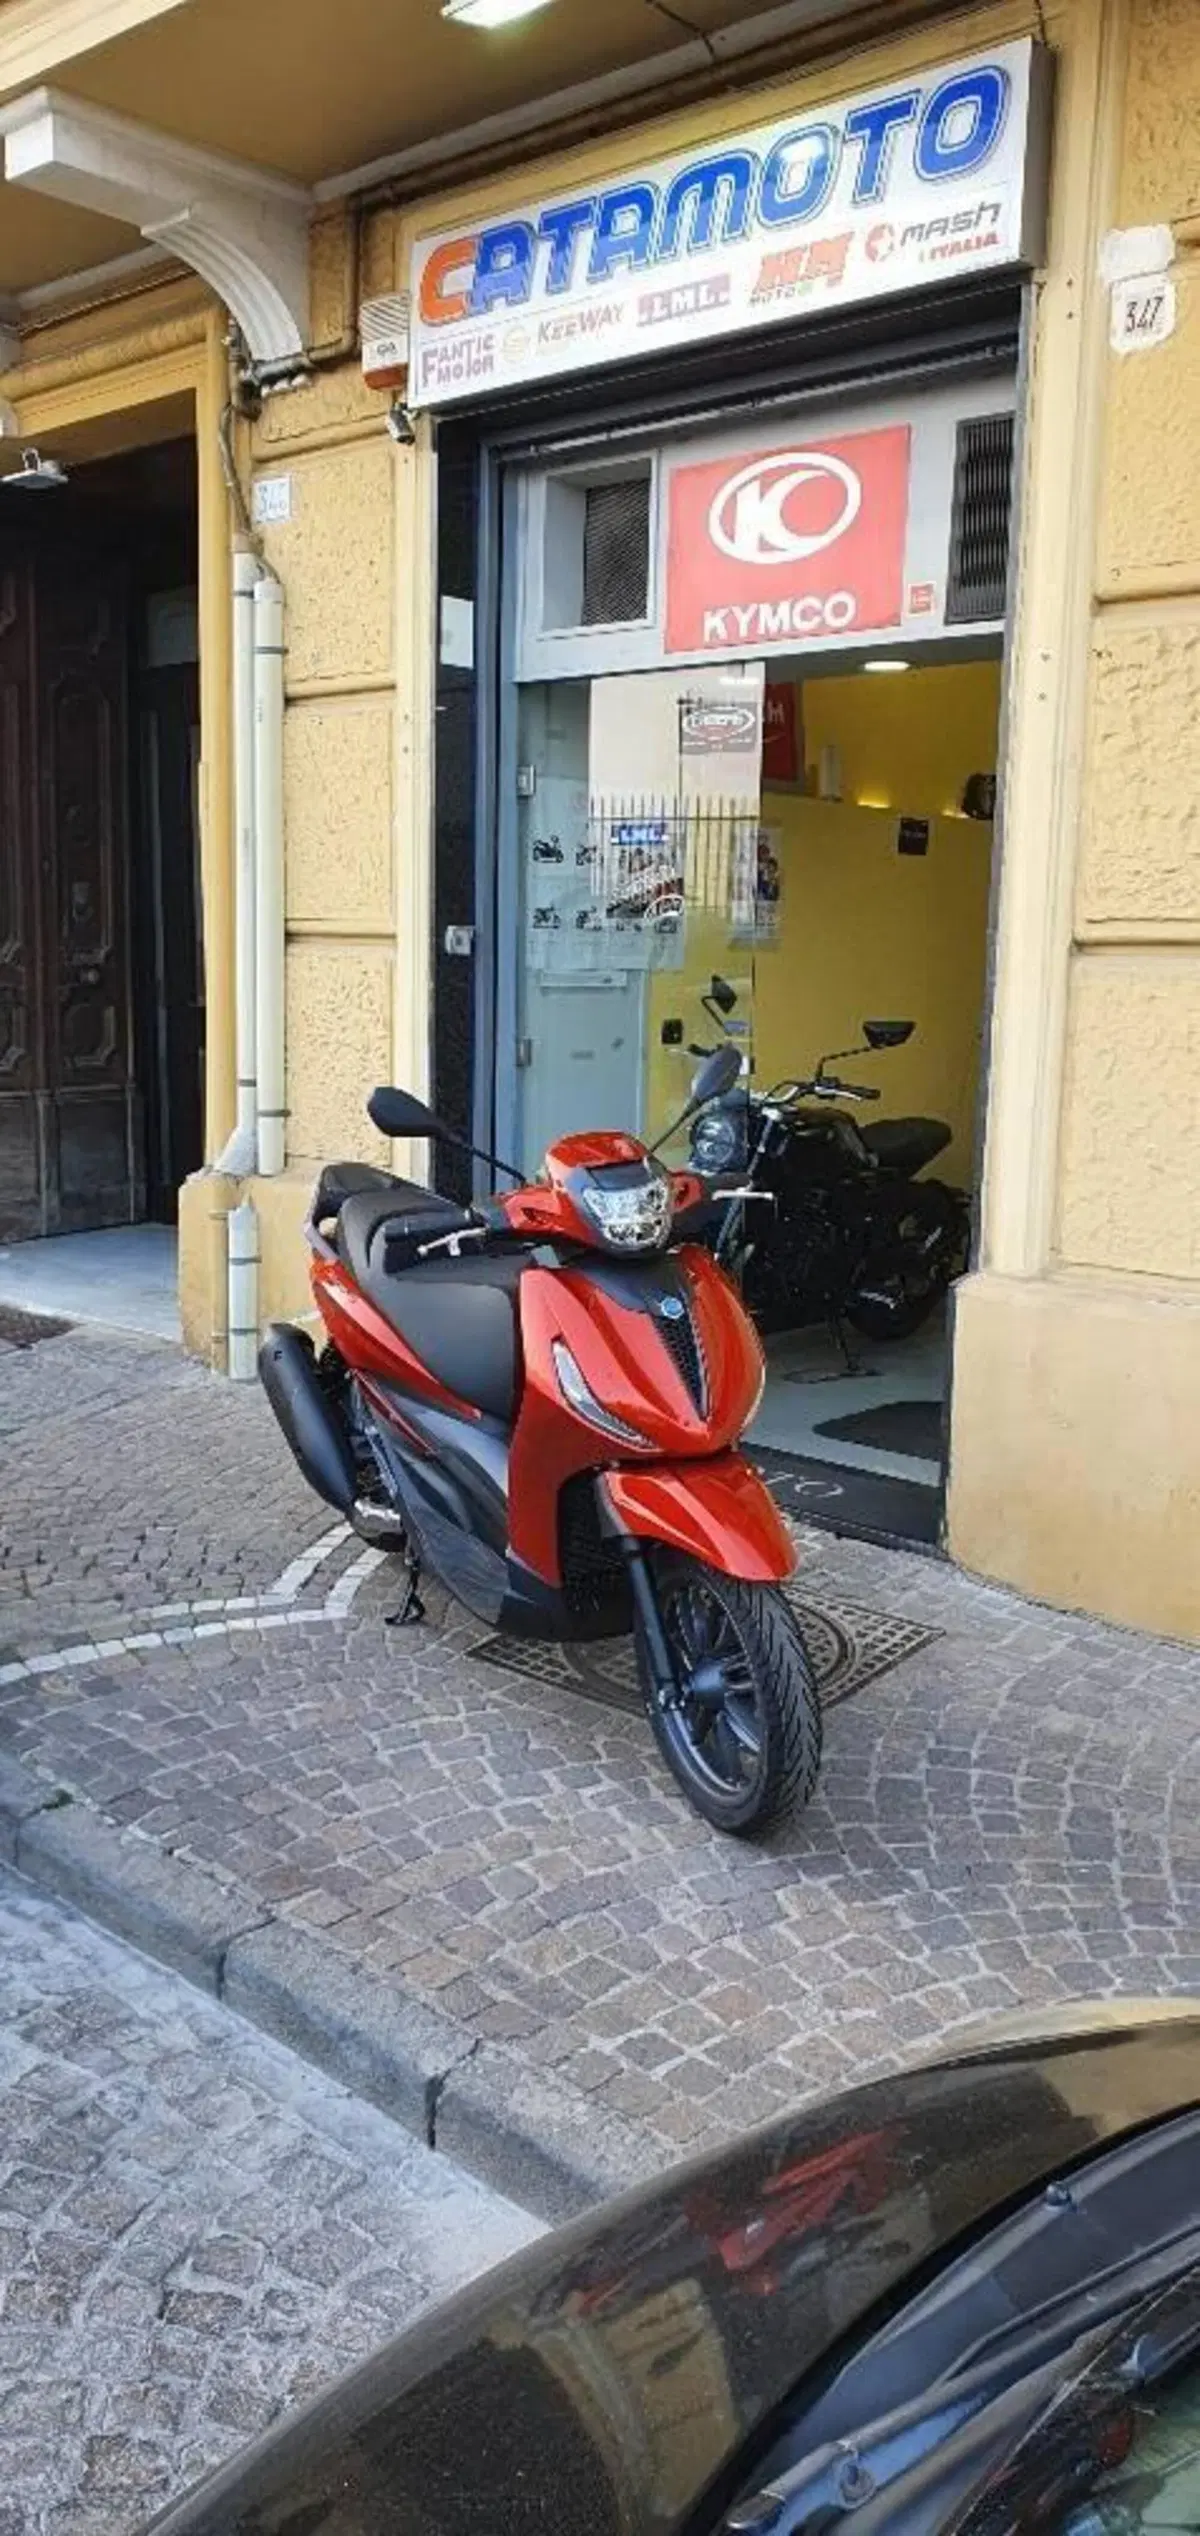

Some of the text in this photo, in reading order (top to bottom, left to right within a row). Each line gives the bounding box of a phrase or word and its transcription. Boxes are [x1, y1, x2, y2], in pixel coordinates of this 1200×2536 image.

[419, 65, 1010, 326] CATAMOTO
[1125, 296, 1164, 332] 347
[423, 334, 495, 388] FANTIC
[703, 590, 857, 643] KYMCO
